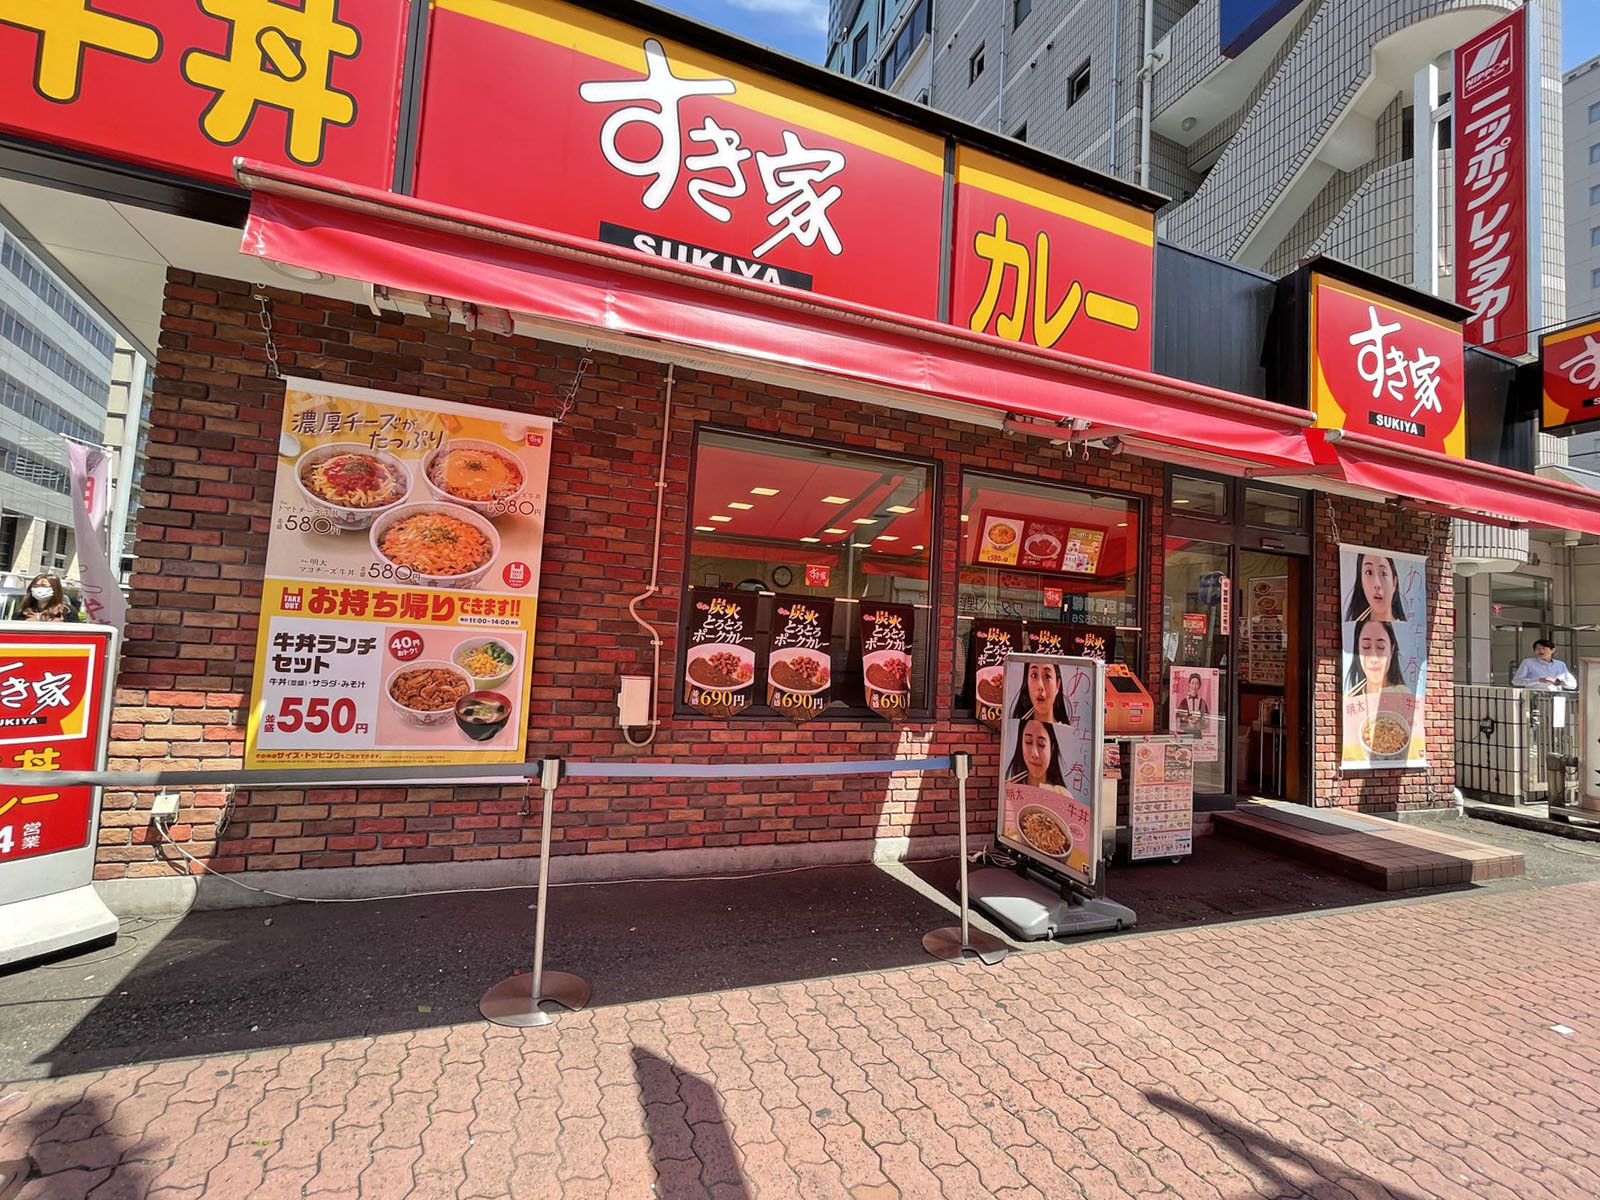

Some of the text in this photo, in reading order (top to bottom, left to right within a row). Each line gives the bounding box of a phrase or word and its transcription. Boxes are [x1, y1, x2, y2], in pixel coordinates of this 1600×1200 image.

[579, 38, 846, 258] すき家
[1463, 86, 1512, 344] ニッポンレンタカー
[970, 213, 1139, 349] カレー
[1350, 305, 1442, 417] すき家
[291, 411, 417, 434] 濃厚チーズが
[1375, 413, 1419, 436] SUKIYA
[369, 430, 444, 451] たっぷり
[367, 562, 421, 582] 580円
[283, 594, 301, 602] TAKE
[284, 602, 300, 610] OUT
[708, 598, 742, 620] 炭火
[788, 604, 820, 626] 炭火
[702, 614, 743, 632] とろとろ
[783, 619, 822, 638] とろとろ
[875, 610, 902, 629] 炭火
[692, 628, 753, 644] ポークカレー
[774, 633, 830, 649] ポークカレー
[872, 624, 906, 640] とろとろ
[987, 627, 1011, 646] 炭火
[1038, 630, 1061, 648] 炭火
[1085, 633, 1105, 650] 炭火
[273, 632, 377, 655] 牛丼ランチ
[391, 636, 420, 650] 40円
[983, 641, 1014, 655] とろとろ
[271, 654, 330, 674] セット
[977, 654, 1007, 666] ポーク
[0, 661, 73, 716] き家
[700, 689, 745, 707] 690円
[782, 692, 824, 710] 690円
[264, 696, 369, 735] 並盛 550円
[1067, 803, 1089, 825] 牛丼
[22, 821, 42, 849] 営業
